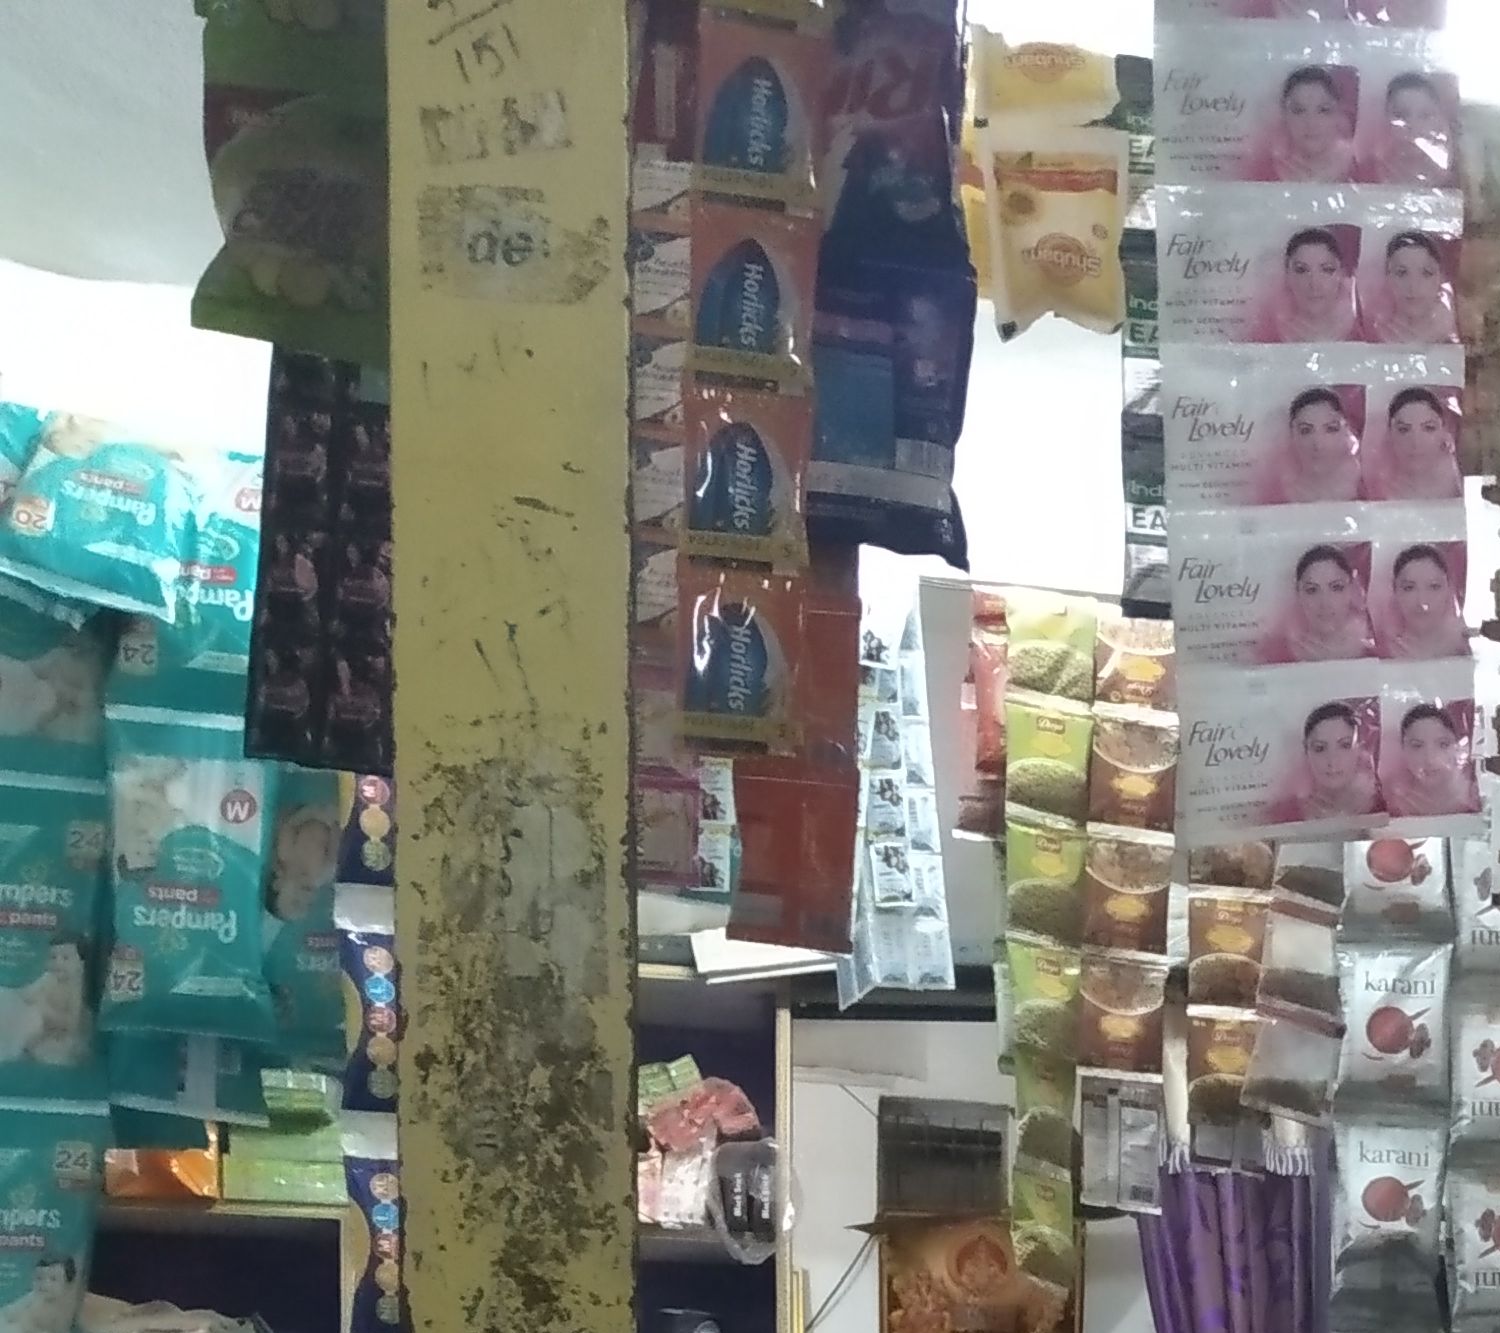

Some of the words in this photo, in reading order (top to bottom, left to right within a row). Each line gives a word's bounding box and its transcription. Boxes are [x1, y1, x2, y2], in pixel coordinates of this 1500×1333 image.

[1164, 69, 1203, 92] Fair
[1180, 91, 1245, 117] Lovely
[750, 79, 773, 168] Horlicks
[1166, 233, 1205, 257] Fair
[1183, 252, 1249, 279] Lovely
[742, 262, 764, 348] Horlicks
[1172, 396, 1215, 420] Fair
[1188, 419, 1254, 442] Lovely
[734, 444, 756, 530] Horlicks
[1178, 557, 1221, 581] Fair
[1195, 578, 1261, 603] Lovely
[728, 627, 751, 711] Horlicks
[1188, 720, 1226, 746] Fair
[1204, 741, 1270, 766] Lovely
[132, 905, 238, 943] Pampers
[1364, 971, 1436, 995] karani
[1358, 1141, 1430, 1167] karani
